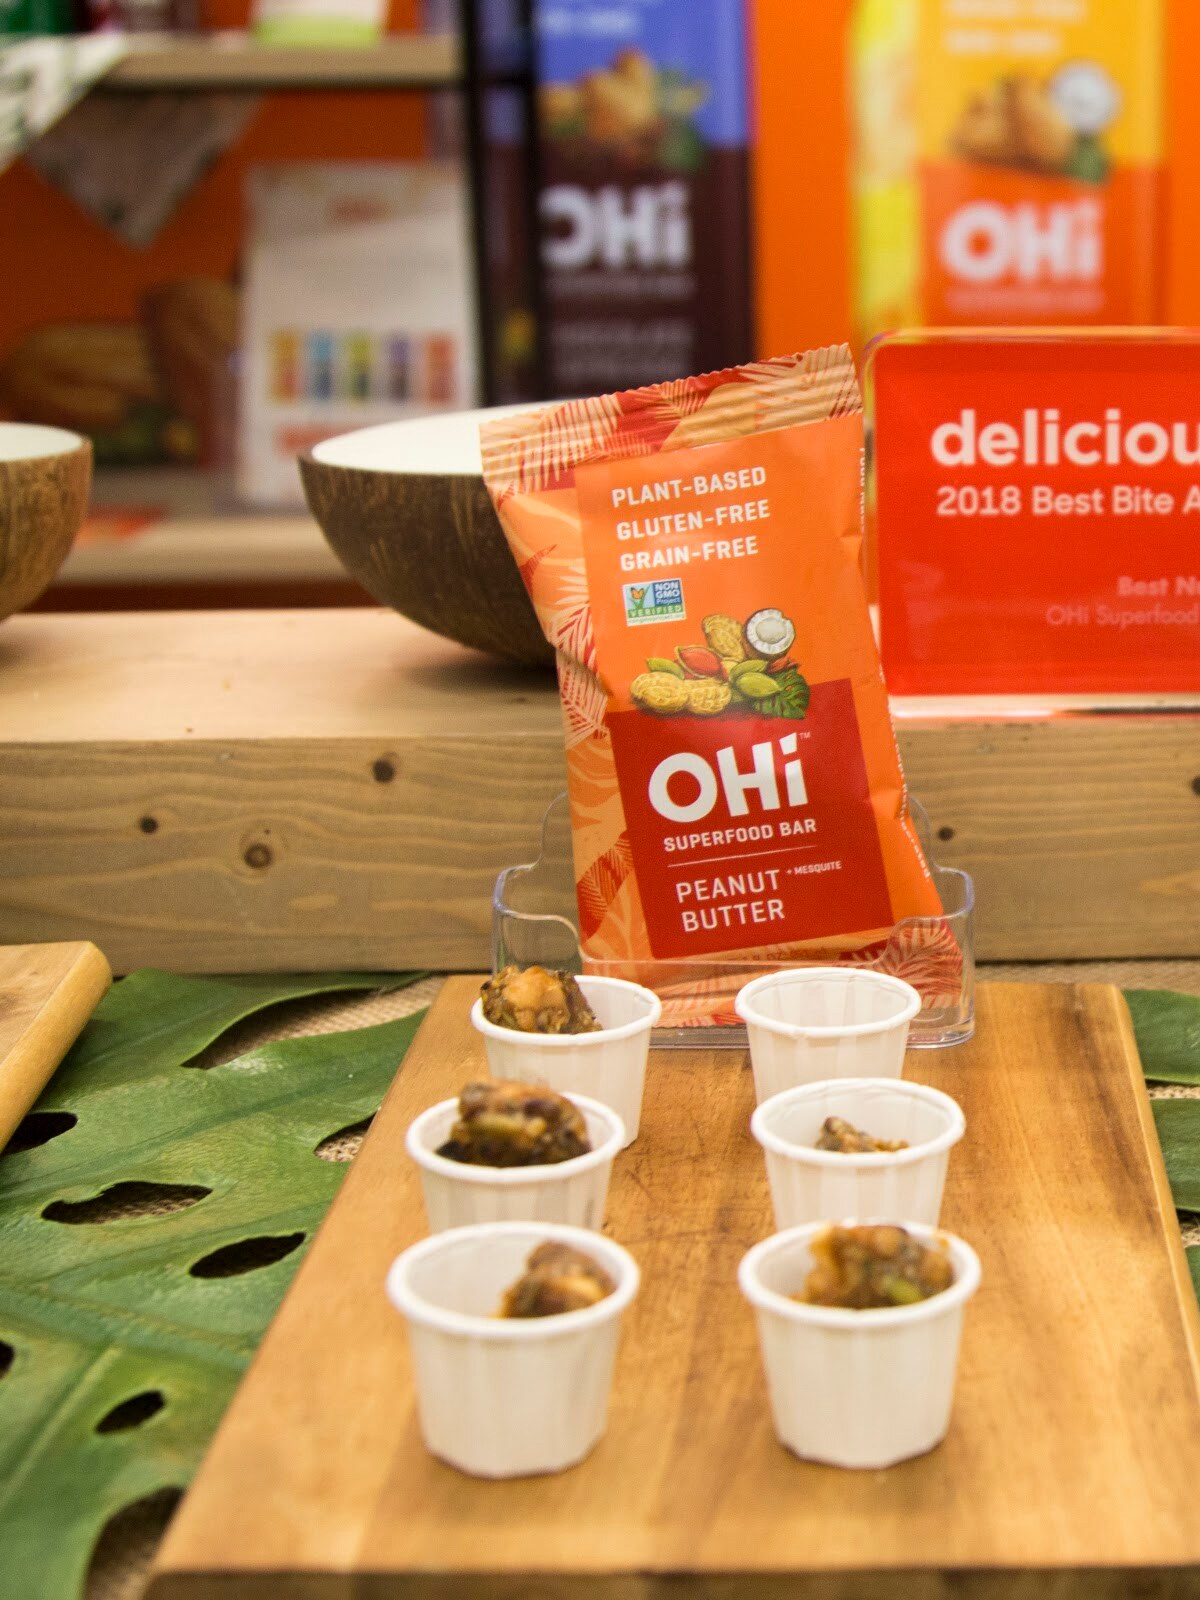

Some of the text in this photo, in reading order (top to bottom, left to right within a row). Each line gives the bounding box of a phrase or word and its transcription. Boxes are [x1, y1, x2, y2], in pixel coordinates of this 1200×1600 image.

[940, 198, 1103, 282] OHi
[611, 466, 767, 508] PLANT-BASED
[937, 485, 1021, 516] 2018
[1032, 485, 1104, 515] Best
[1112, 485, 1175, 515] Bite
[616, 499, 771, 541] GLUTEN-FREE
[620, 536, 759, 571] GRAIN-FREE
[654, 581, 679, 591] NON
[655, 589, 680, 599] GMO
[1118, 576, 1168, 595] Best
[629, 604, 682, 617] VERIFIED
[1097, 604, 1199, 629] Superfood
[648, 732, 809, 823] OHi
[664, 818, 816, 852] SUPERFOOD BAR
[794, 861, 842, 875] MESQUITE
[676, 870, 780, 903] PEANUT
[681, 899, 785, 932] BUTTER
